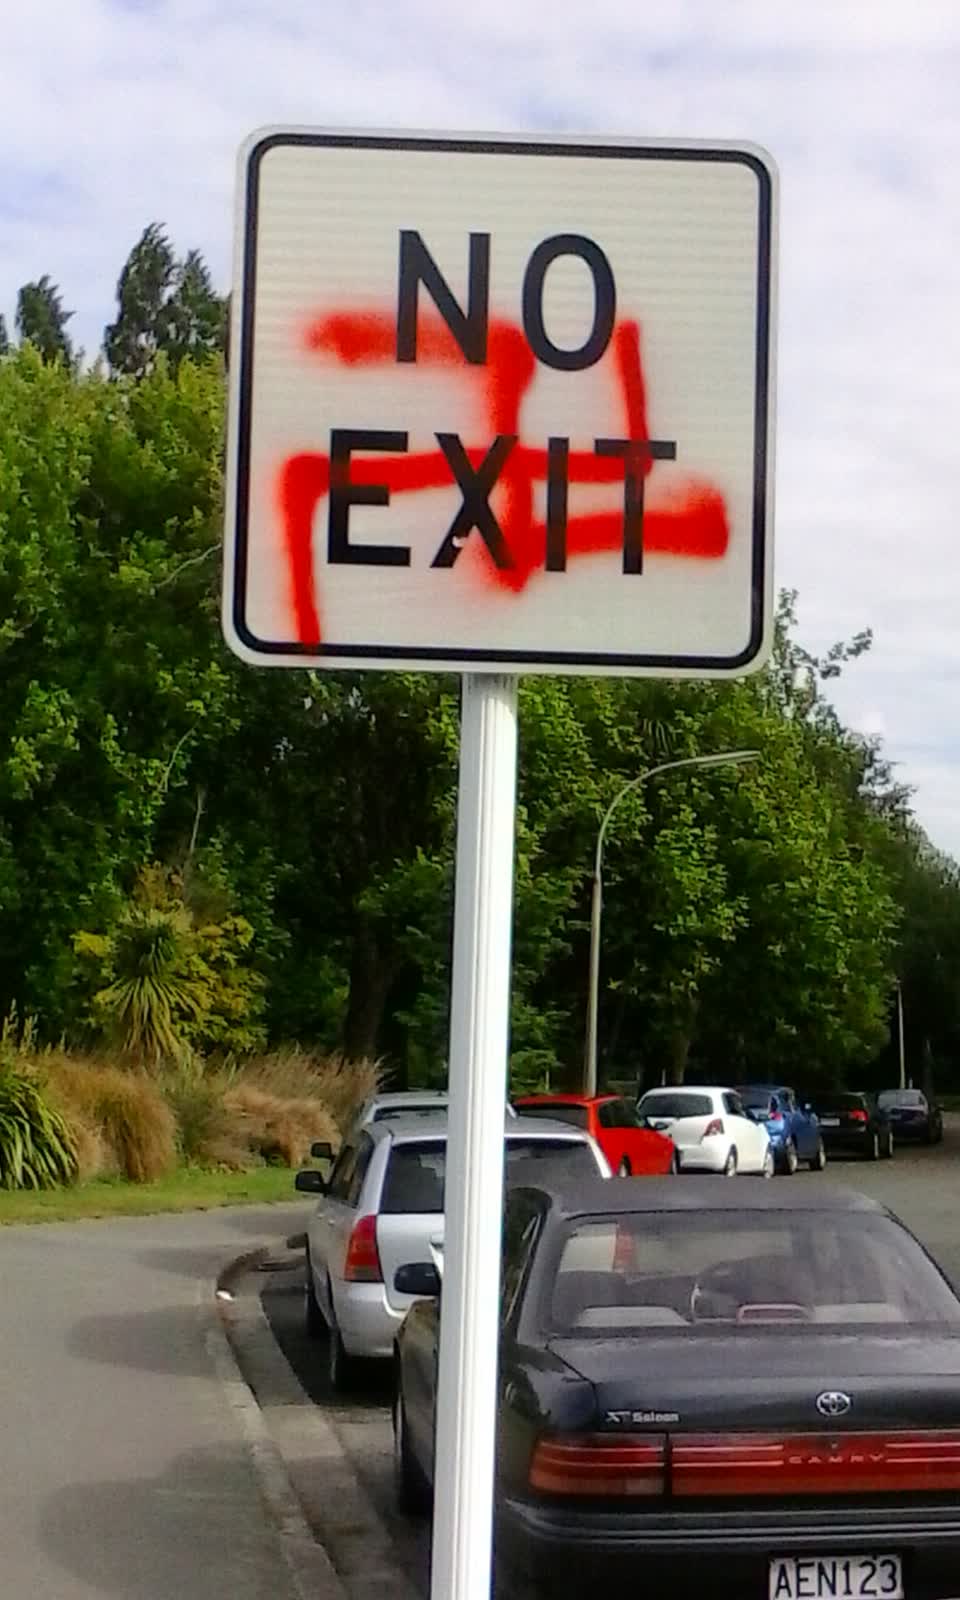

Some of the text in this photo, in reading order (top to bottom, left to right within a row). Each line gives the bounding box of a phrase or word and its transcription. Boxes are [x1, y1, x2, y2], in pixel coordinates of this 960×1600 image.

[395, 229, 617, 371] NO
[327, 428, 677, 576] EXIT
[789, 1454, 884, 1464] CAMRY
[775, 1559, 898, 1599] AEN123
